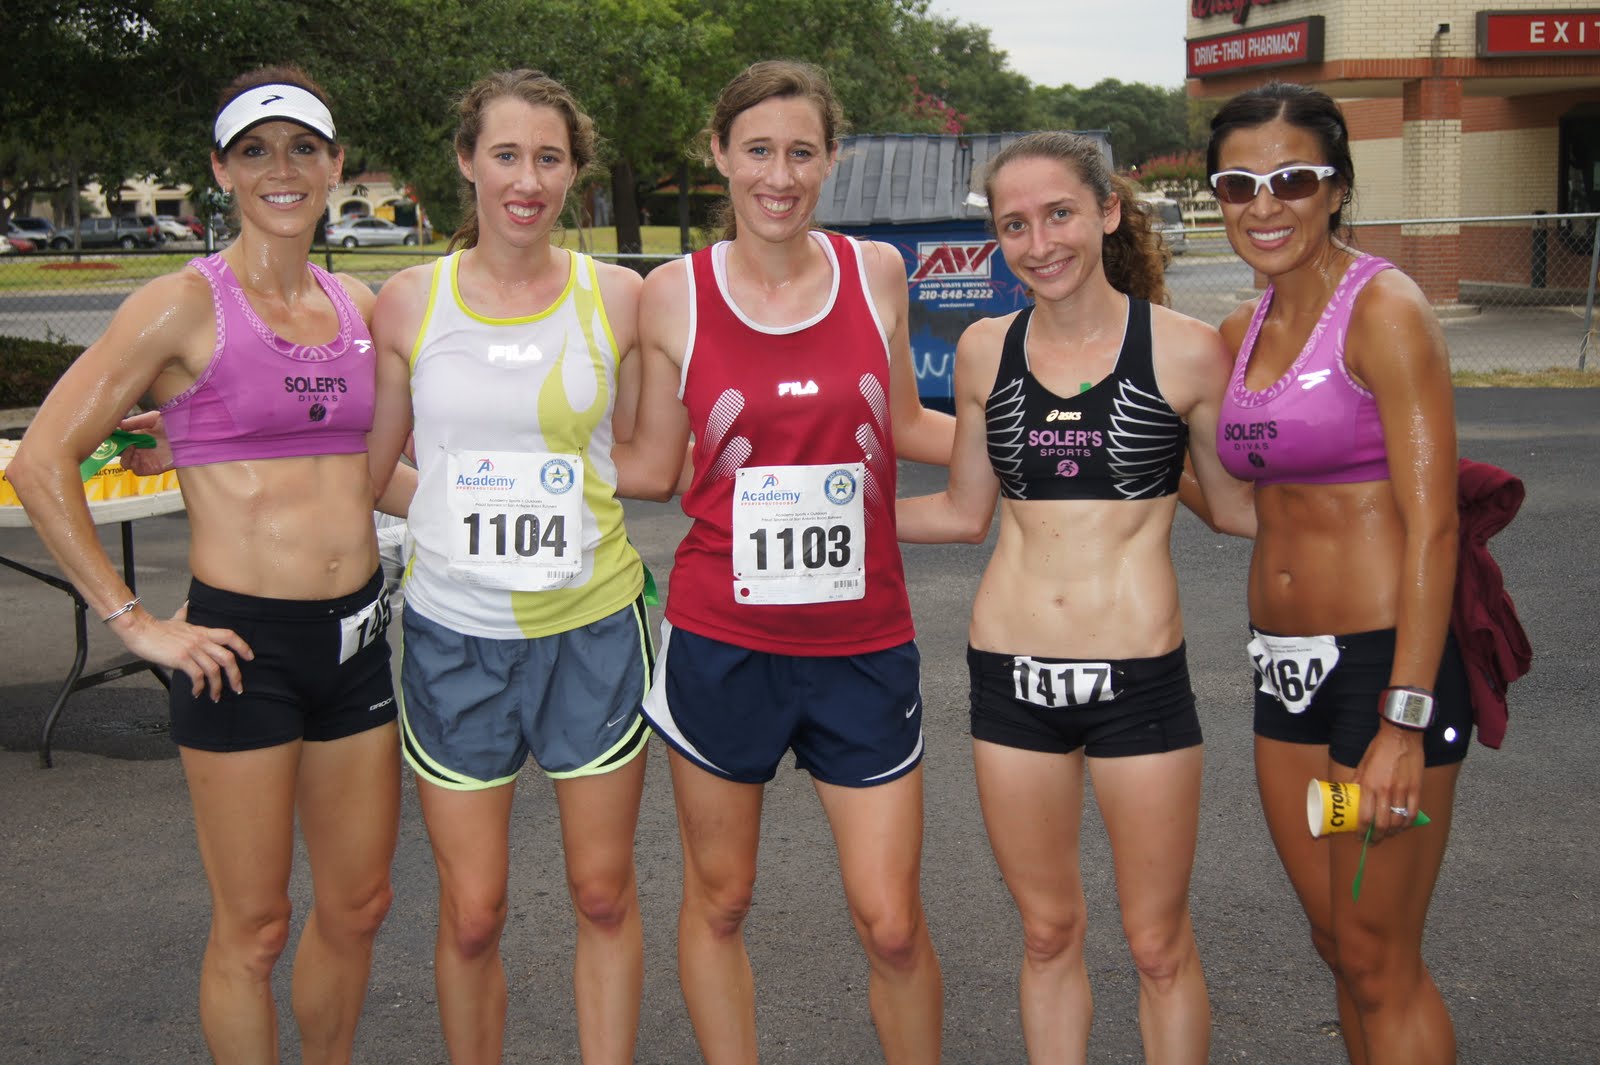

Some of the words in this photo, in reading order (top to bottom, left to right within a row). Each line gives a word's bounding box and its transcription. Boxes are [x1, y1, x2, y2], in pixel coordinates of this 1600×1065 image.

[1194, 39, 1246, 67] DRIVE-THRU
[1248, 31, 1301, 58] PHARMACY
[918, 289, 994, 300] 210-648-5222
[488, 344, 542, 362] FILA
[285, 376, 348, 393] SOLER'S
[778, 380, 819, 396] FILA
[1028, 430, 1103, 447] SOLER'S
[1224, 421, 1278, 441] SOLER'S
[1040, 448, 1091, 457] SPORTS
[1234, 443, 1269, 451] DIVAS
[456, 474, 516, 490] Academy
[741, 490, 801, 504] Academy
[463, 513, 567, 557] 1104
[750, 525, 851, 570] 1103
[1014, 663, 1108, 706] 1417
